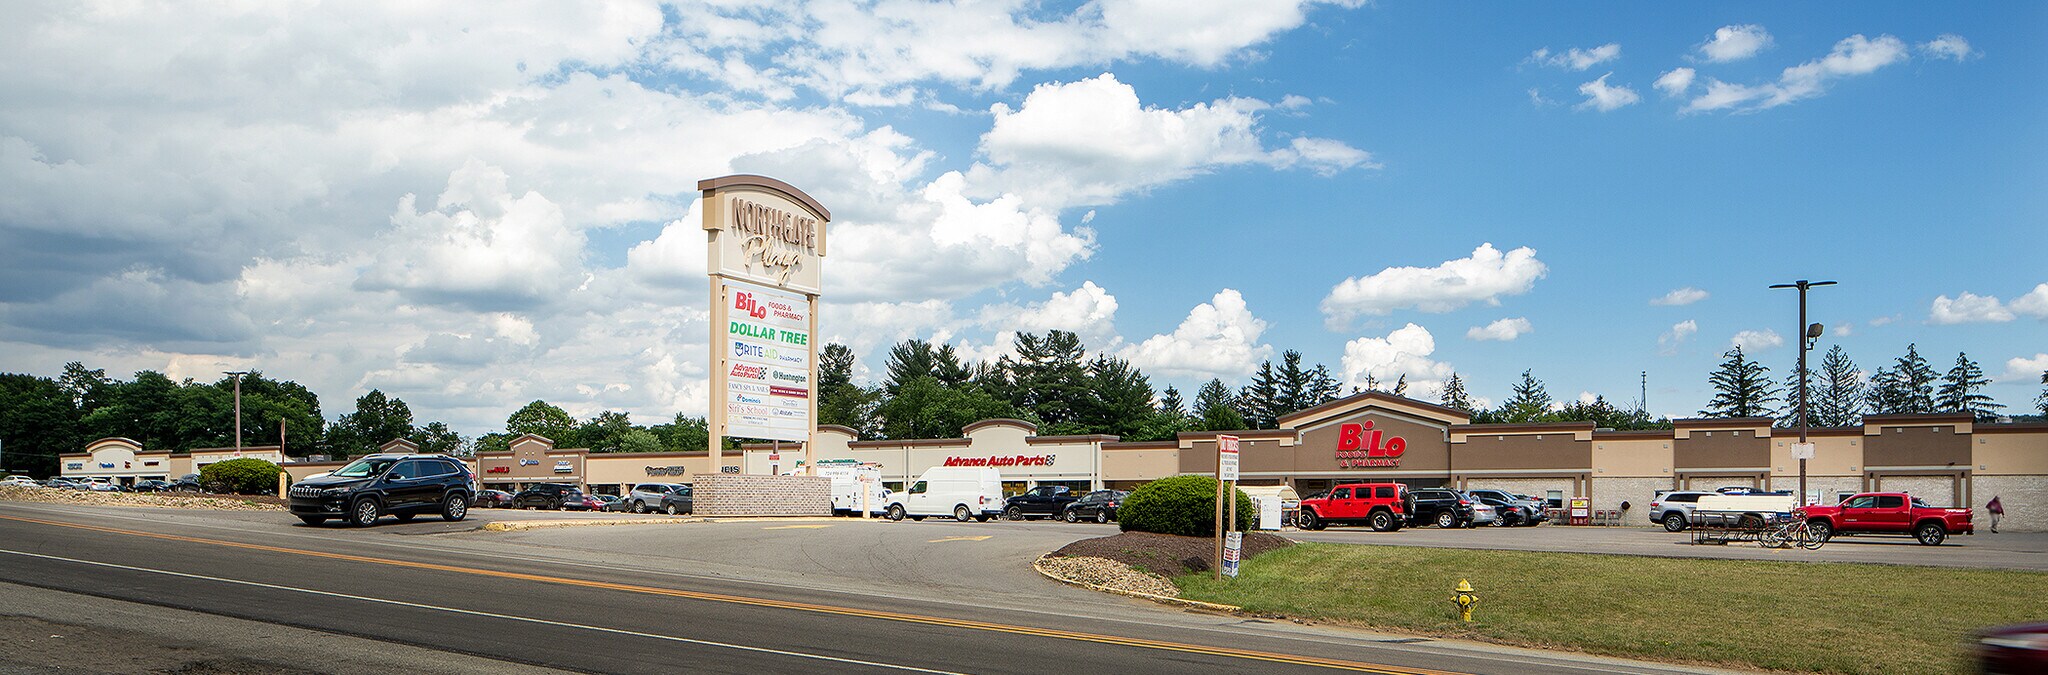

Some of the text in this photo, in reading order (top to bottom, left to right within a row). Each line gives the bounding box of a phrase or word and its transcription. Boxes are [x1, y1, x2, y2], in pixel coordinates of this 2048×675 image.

[731, 197, 815, 249] NORTHGATE
[741, 235, 801, 287] Plaza
[735, 291, 767, 320] BiLo
[767, 301, 787, 311] FOODS
[773, 310, 804, 321] PHARMACY
[729, 321, 808, 345] DOLLAR TREE
[744, 344, 763, 357] RITE
[764, 348, 778, 360] AID
[733, 363, 760, 373] Advance
[778, 372, 807, 384] Huntington
[1337, 419, 1407, 458] BiLo
[943, 454, 1045, 467] Advance Auto Parts
[1335, 450, 1367, 459] FOODS
[1339, 459, 1401, 468] & PHARMACY
